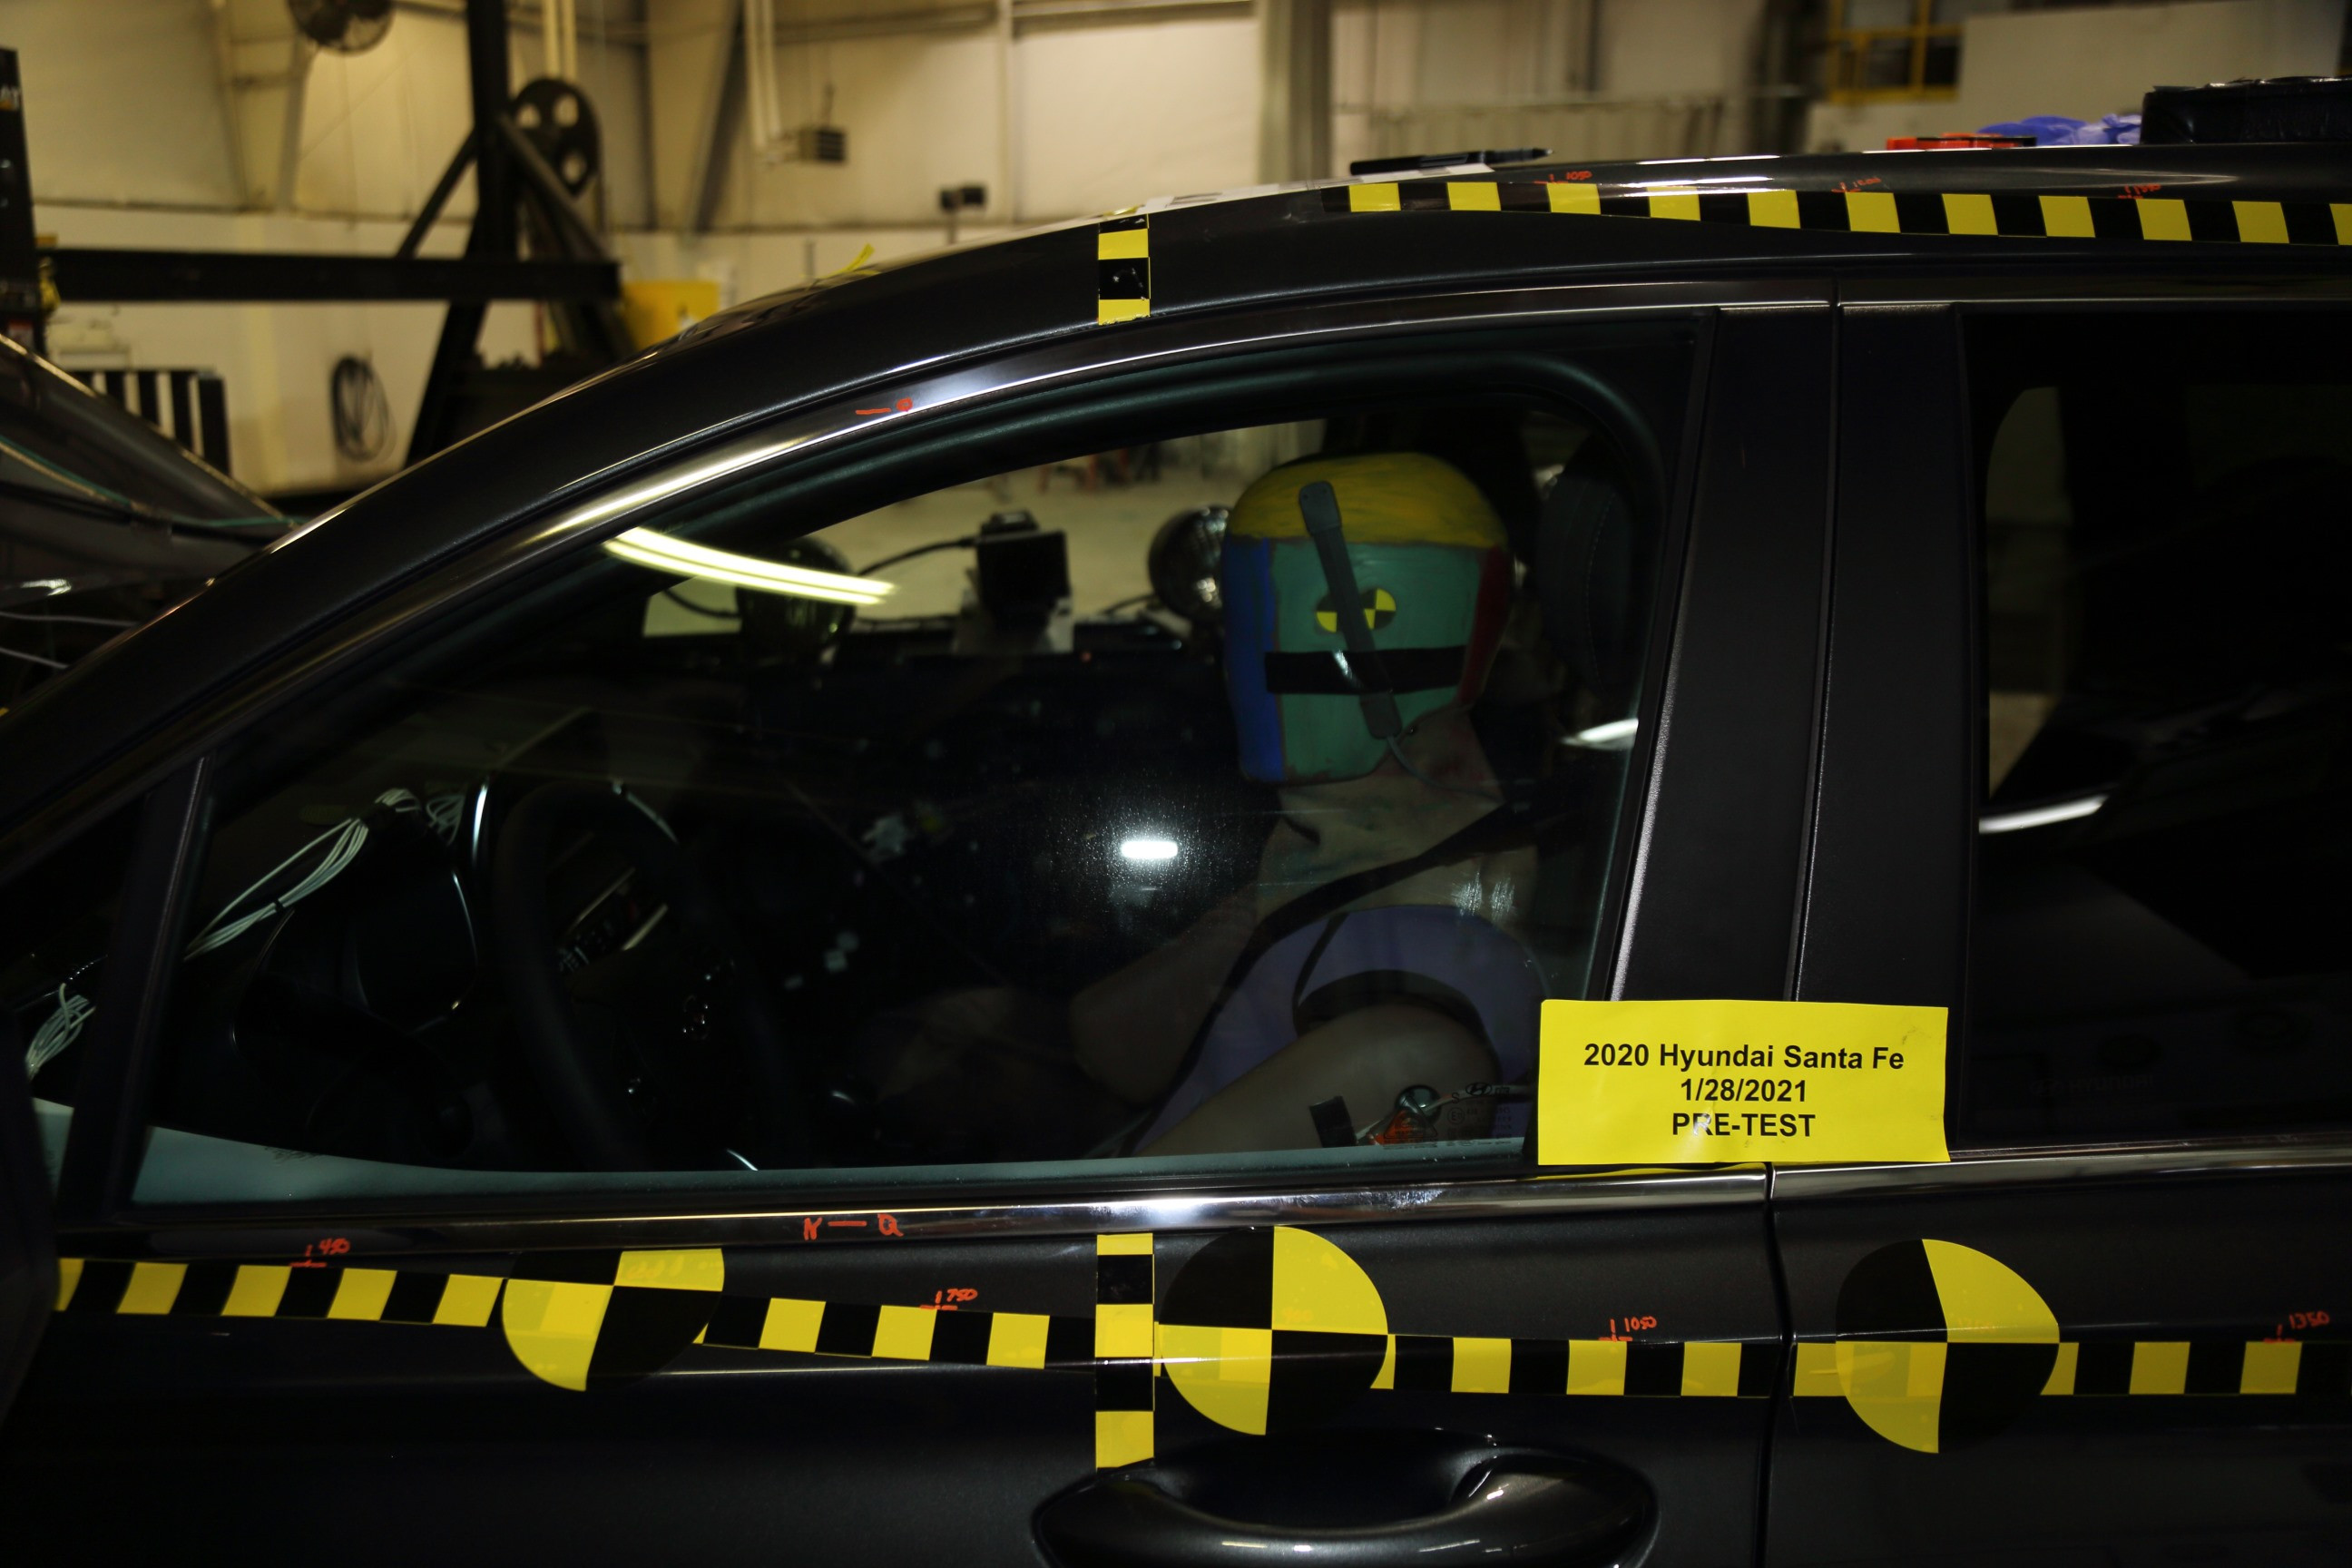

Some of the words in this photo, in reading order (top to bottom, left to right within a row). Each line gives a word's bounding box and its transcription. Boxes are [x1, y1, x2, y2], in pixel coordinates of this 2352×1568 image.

[1584, 1044, 1650, 1066] 2020
[1660, 1044, 1773, 1072] Hyundai
[1784, 1045, 1863, 1070] Santa
[1873, 1047, 1905, 1069] Fe
[1681, 1078, 1807, 1102] 1/28/2021
[1672, 1112, 1816, 1138] PRE-TEST
